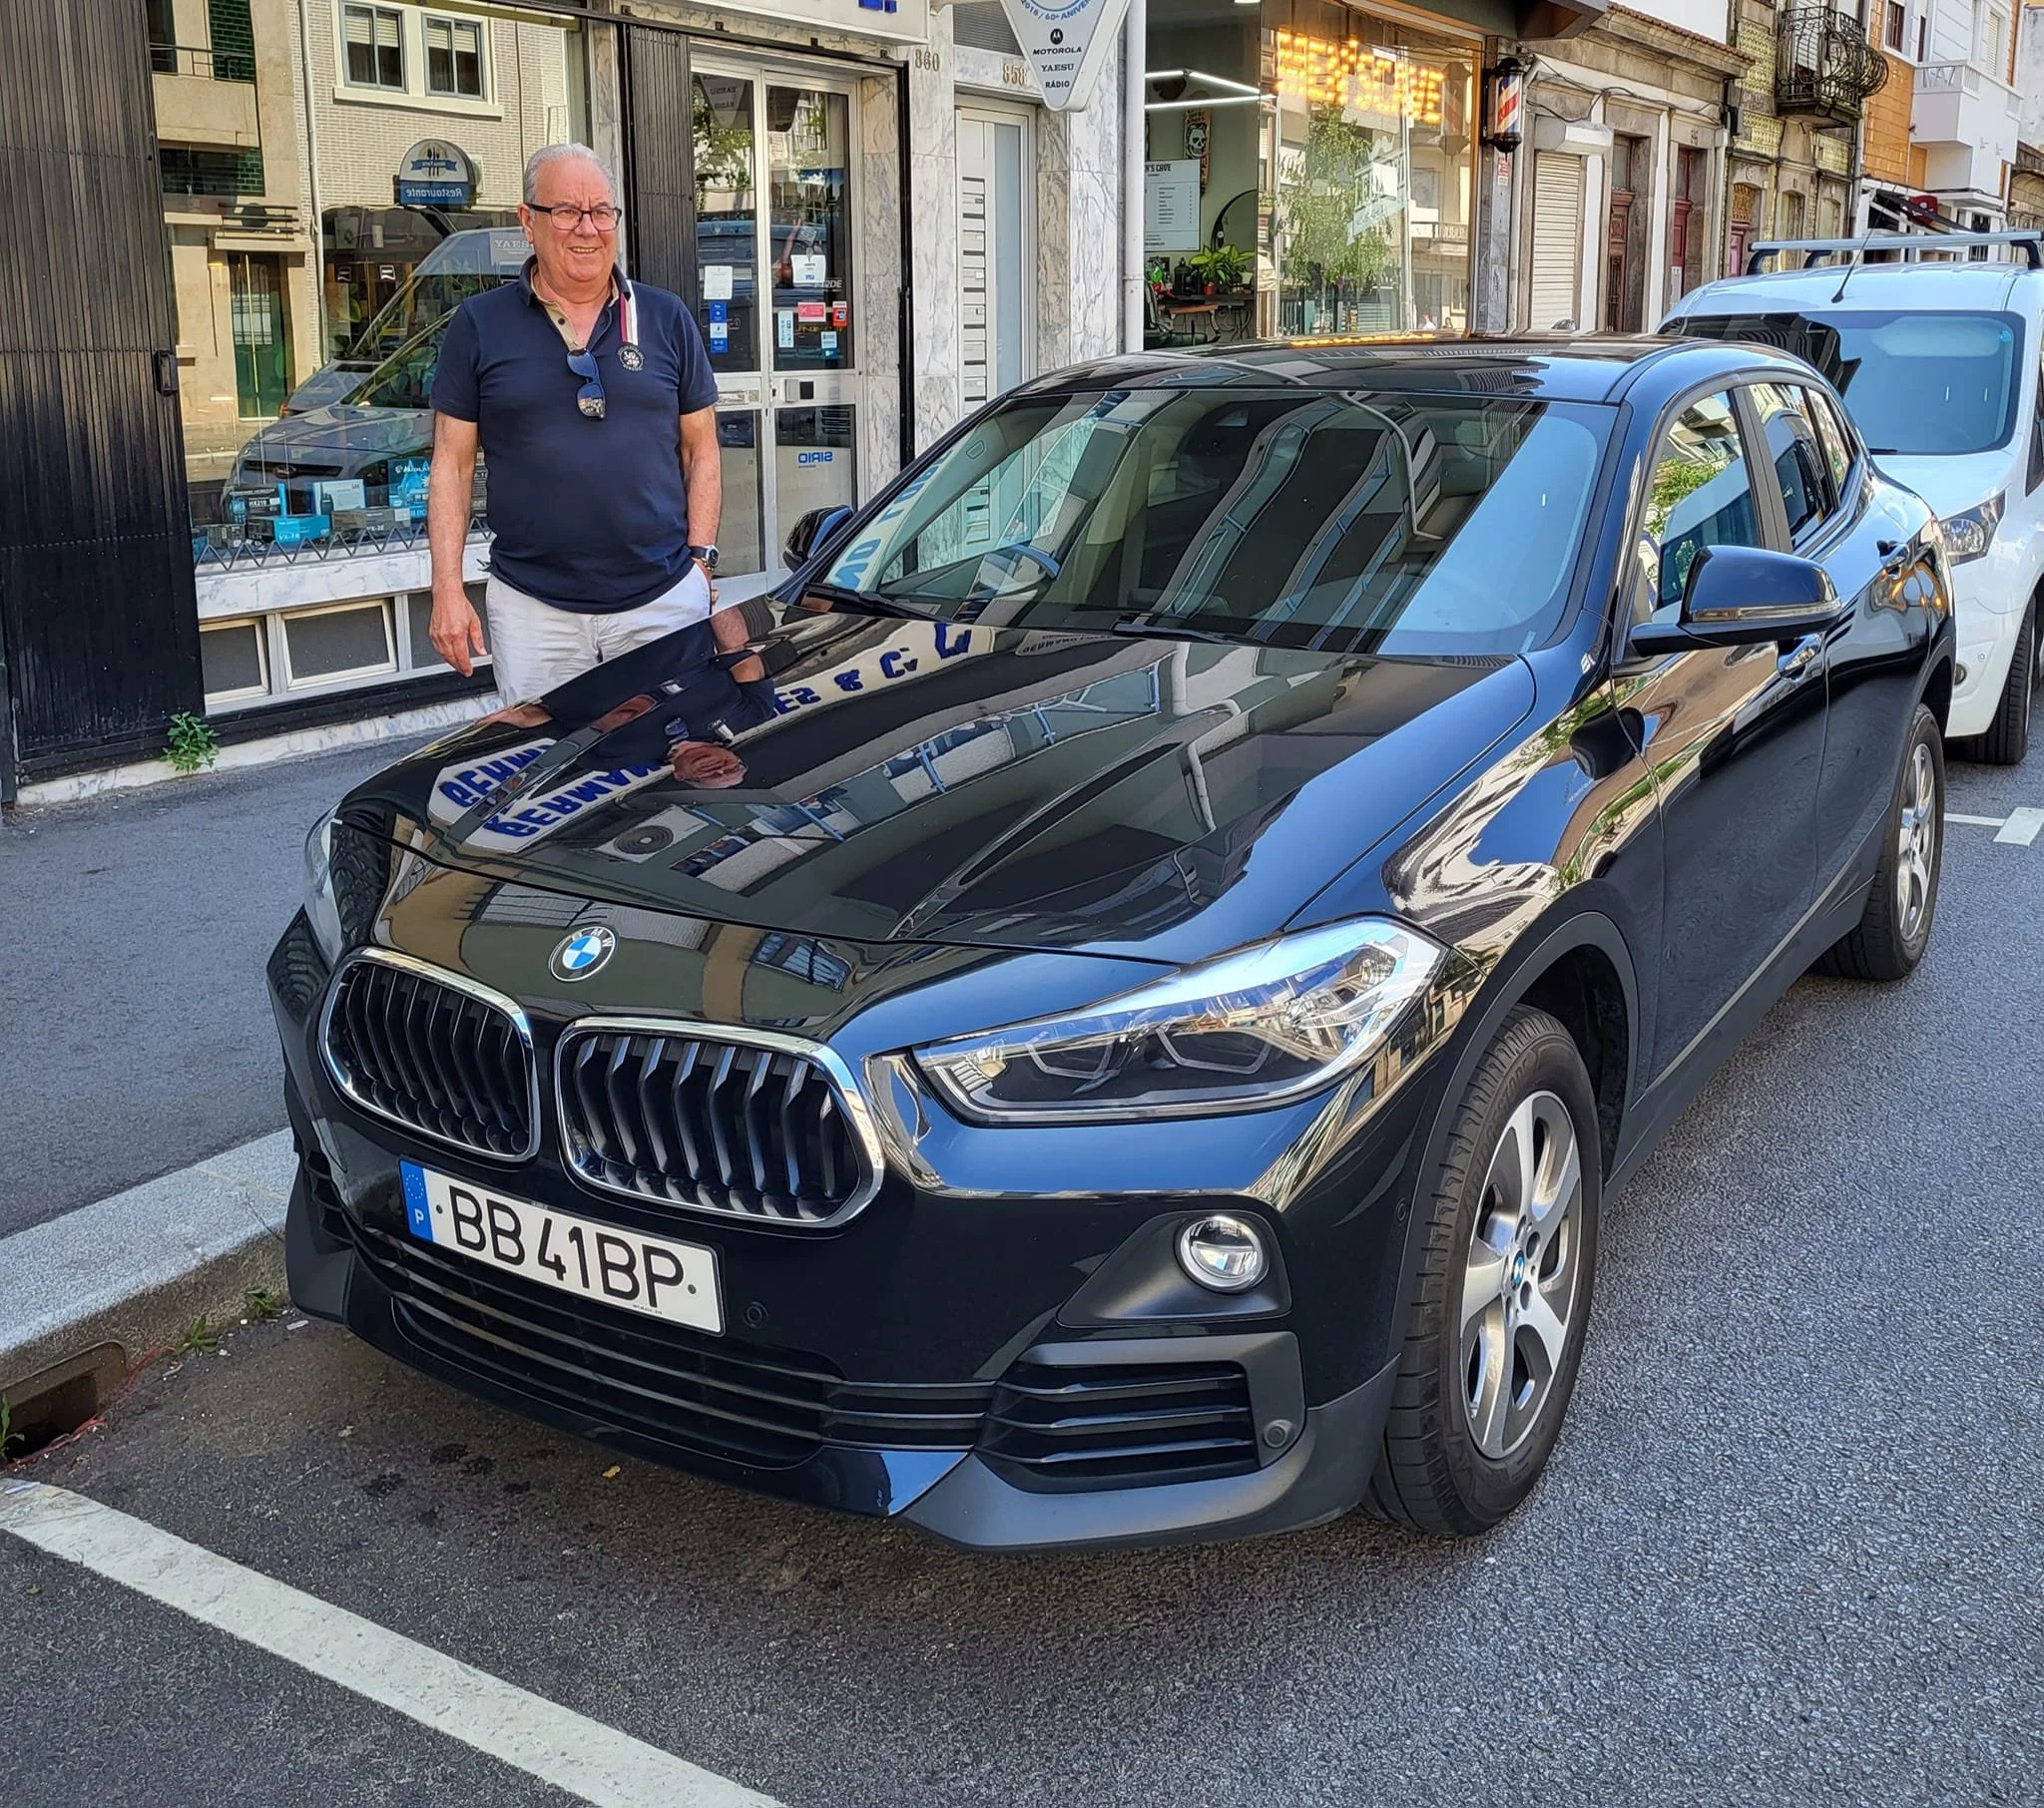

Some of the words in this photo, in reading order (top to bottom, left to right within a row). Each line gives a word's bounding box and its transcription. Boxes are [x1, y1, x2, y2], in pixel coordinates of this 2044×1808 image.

[1032, 46, 1082, 56] MOTOROLA
[914, 50, 940, 72] 860
[1041, 63, 1075, 73] YAESU
[1002, 63, 1027, 87] 858
[1045, 80, 1070, 89] RÁDIO
[494, 239, 532, 249] YAES
[413, 1207, 425, 1225] P
